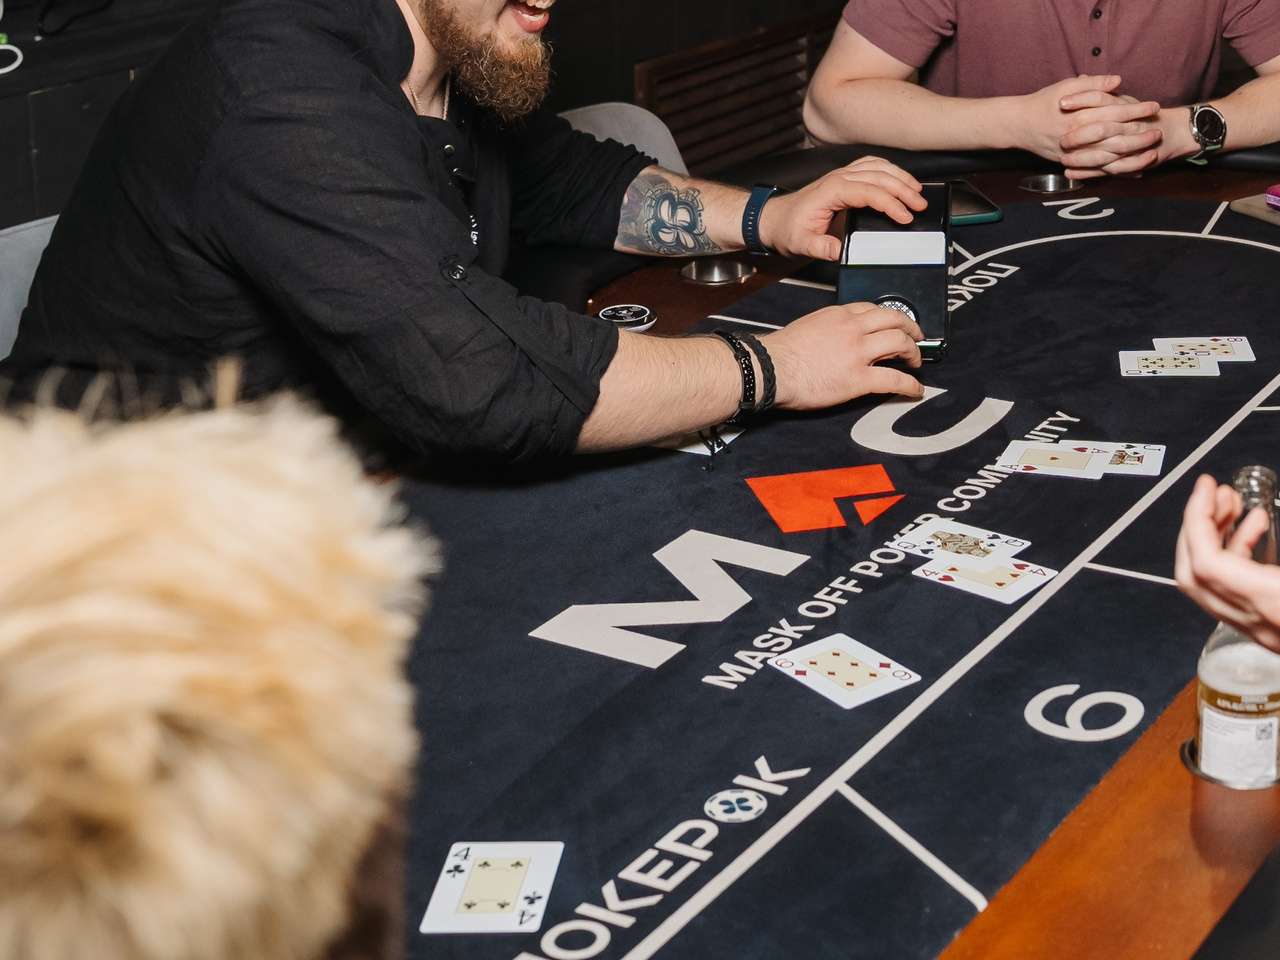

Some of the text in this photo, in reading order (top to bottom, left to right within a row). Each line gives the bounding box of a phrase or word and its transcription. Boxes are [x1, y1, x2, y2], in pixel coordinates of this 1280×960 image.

[701, 618, 816, 690] MASK
[797, 576, 863, 620] OFF
[453, 846, 471, 862] 4
[519, 908, 537, 926] 4
